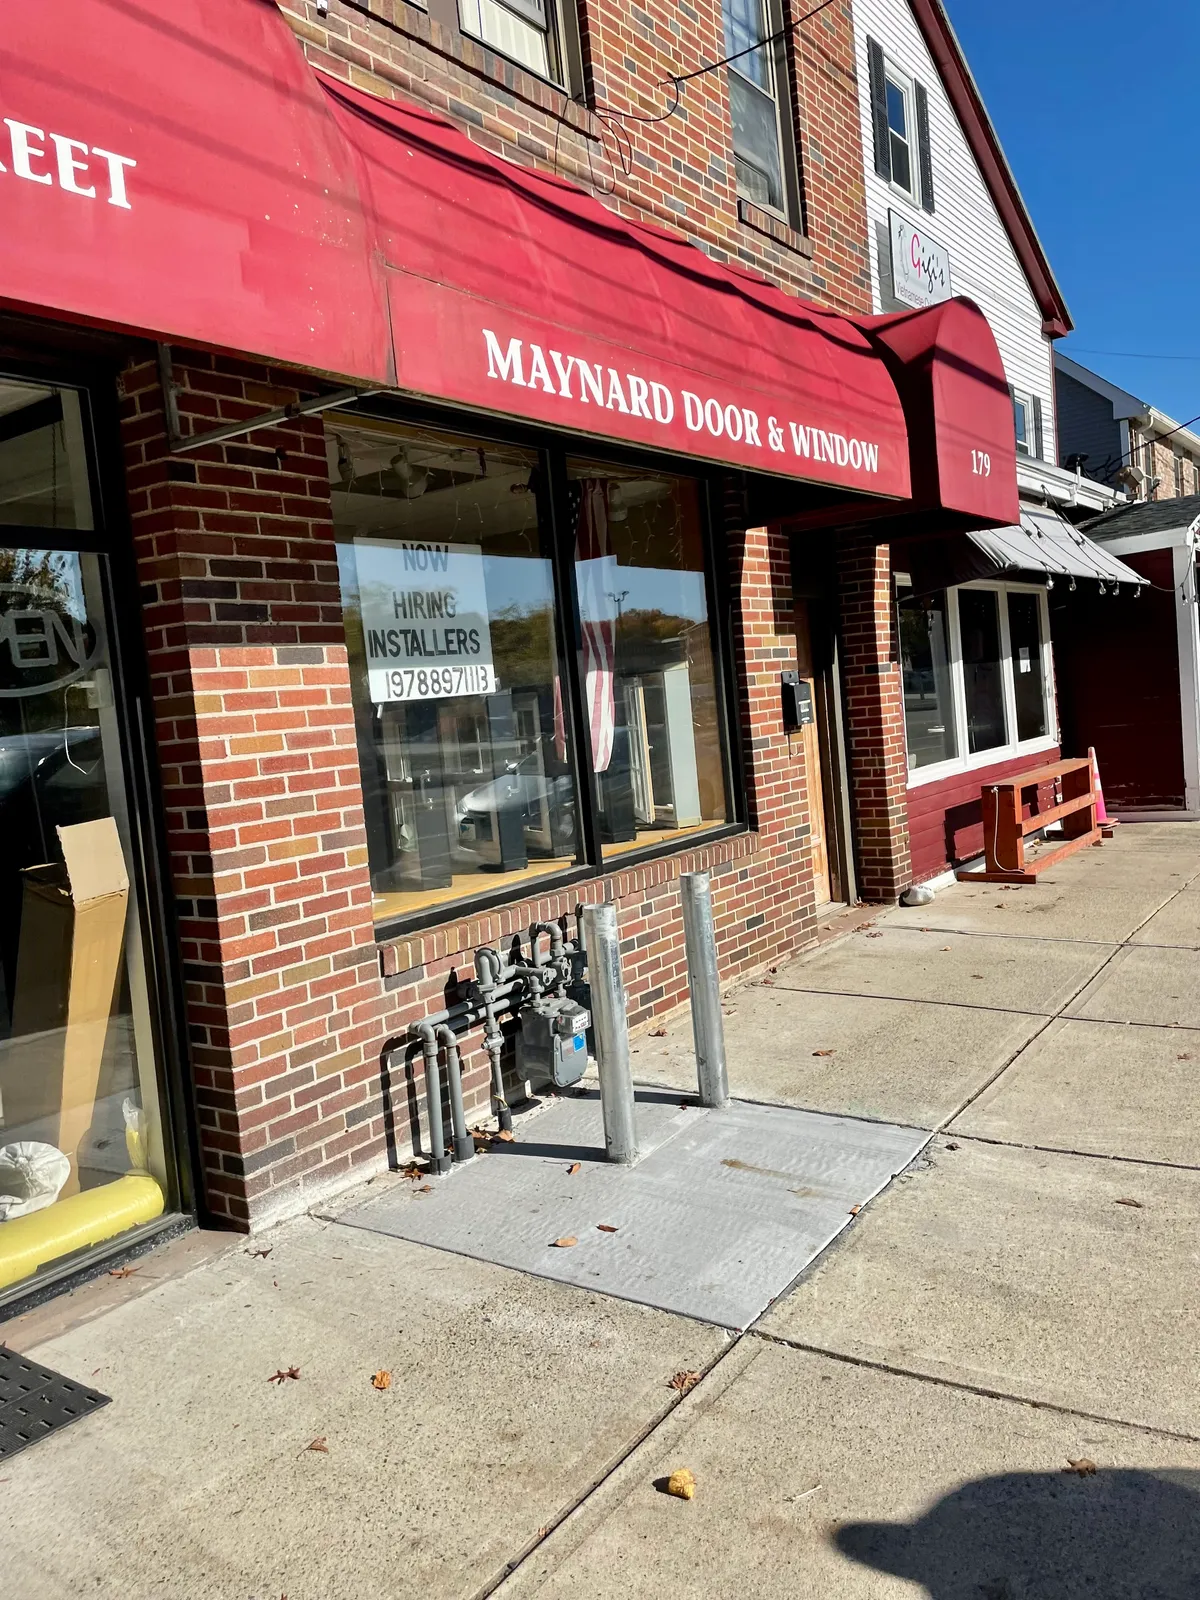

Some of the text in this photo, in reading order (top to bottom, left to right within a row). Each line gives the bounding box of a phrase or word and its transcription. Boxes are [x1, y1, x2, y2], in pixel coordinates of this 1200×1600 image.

[0, 117, 137, 210] EET
[911, 233, 945, 294] Gigi's
[482, 328, 879, 473] MAYNARD DOOR & WINDOW
[971, 449, 991, 478] 179
[402, 543, 449, 572] NOW
[392, 591, 457, 619] HIRING
[367, 628, 481, 658] INSTALLERS
[385, 666, 489, 699] 19788971113
